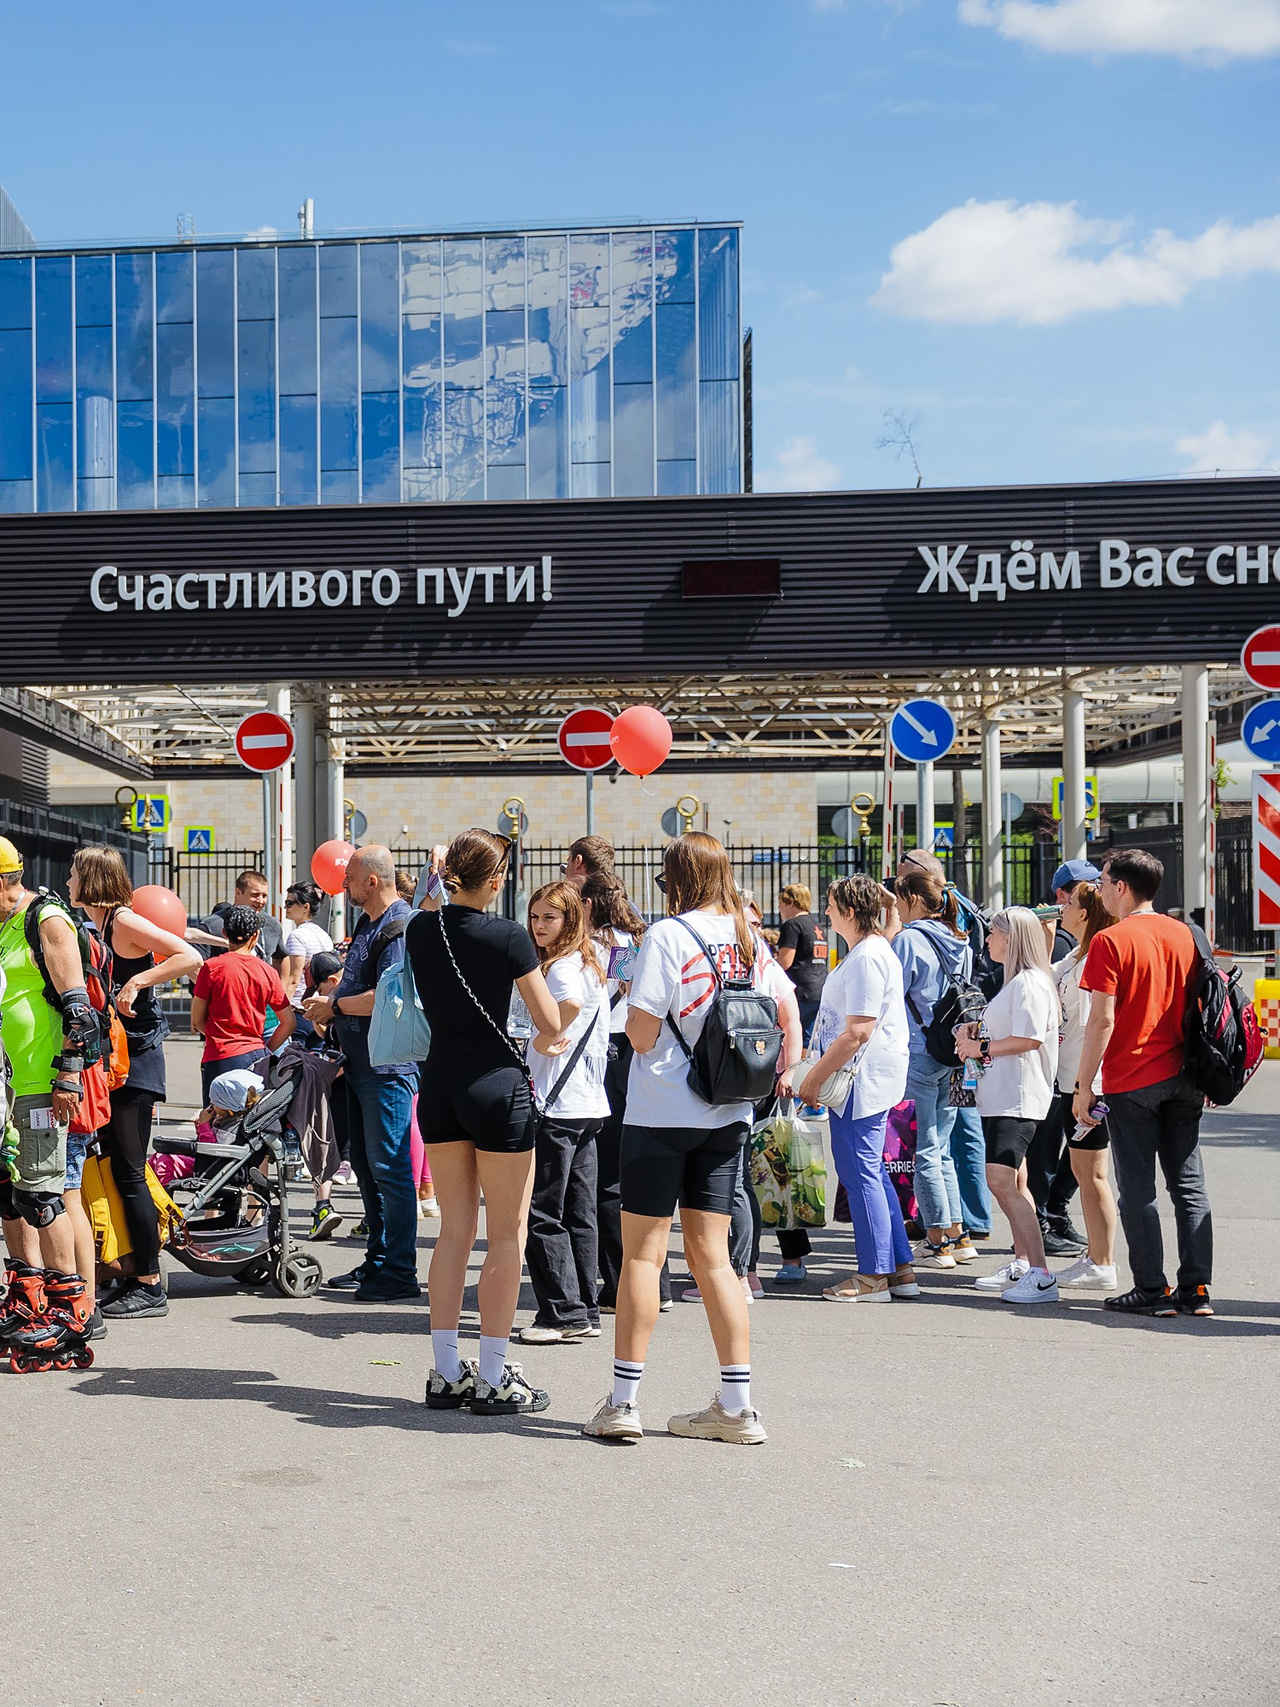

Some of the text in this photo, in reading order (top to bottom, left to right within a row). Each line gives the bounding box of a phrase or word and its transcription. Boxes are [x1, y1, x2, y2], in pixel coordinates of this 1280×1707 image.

[90, 556, 553, 617] Счастливого пути!
[917, 539, 1280, 602] Ждём Вас сн
